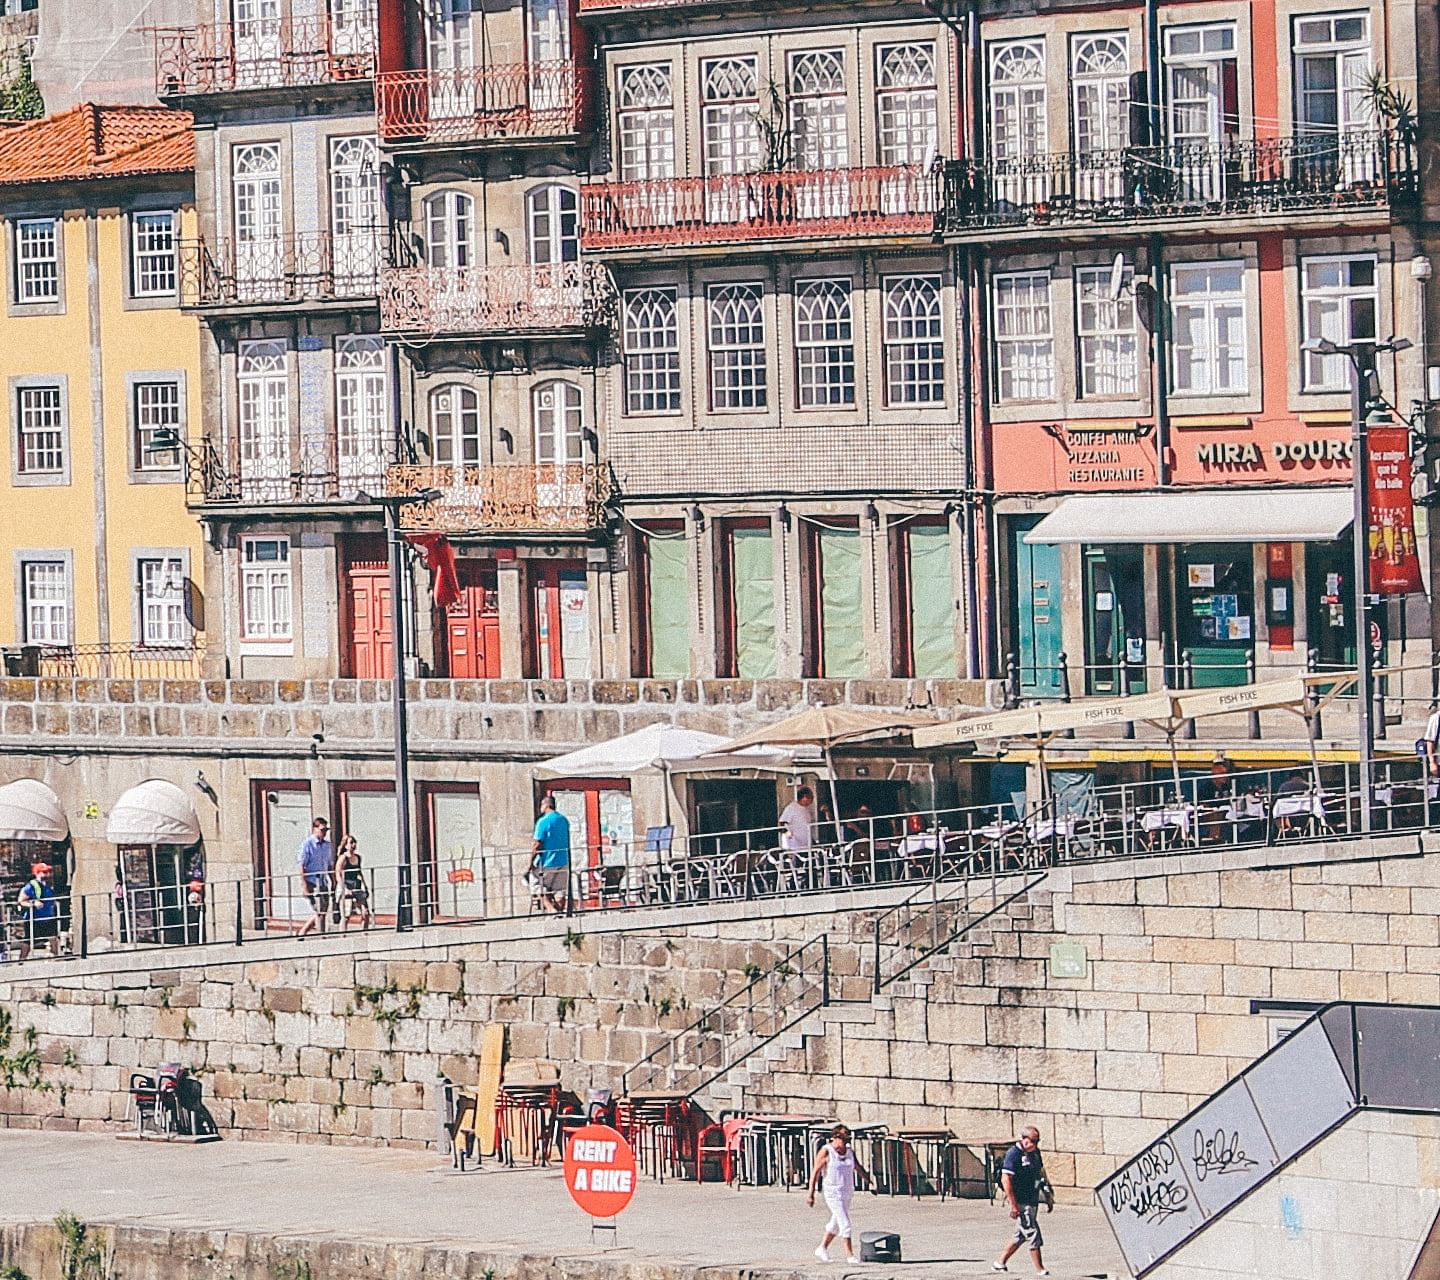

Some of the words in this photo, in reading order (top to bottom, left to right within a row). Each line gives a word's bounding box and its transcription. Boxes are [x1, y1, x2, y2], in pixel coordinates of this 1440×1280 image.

[1067, 432, 1137, 446] CONFEIARIA
[1068, 451, 1121, 464] PIZZARIA
[1196, 442, 1258, 463] MIRA
[1069, 468, 1144, 482] RESTAURANTE
[1219, 694, 1237, 705] FISH
[1239, 691, 1257, 701] FIXE
[1085, 709, 1104, 720] FISH
[1106, 706, 1123, 717] FIXE
[956, 725, 974, 735] FISH
[976, 722, 993, 732] FIXE
[573, 1139, 617, 1163] RENT
[573, 1168, 588, 1191] A
[591, 1168, 633, 1193] BIKE
